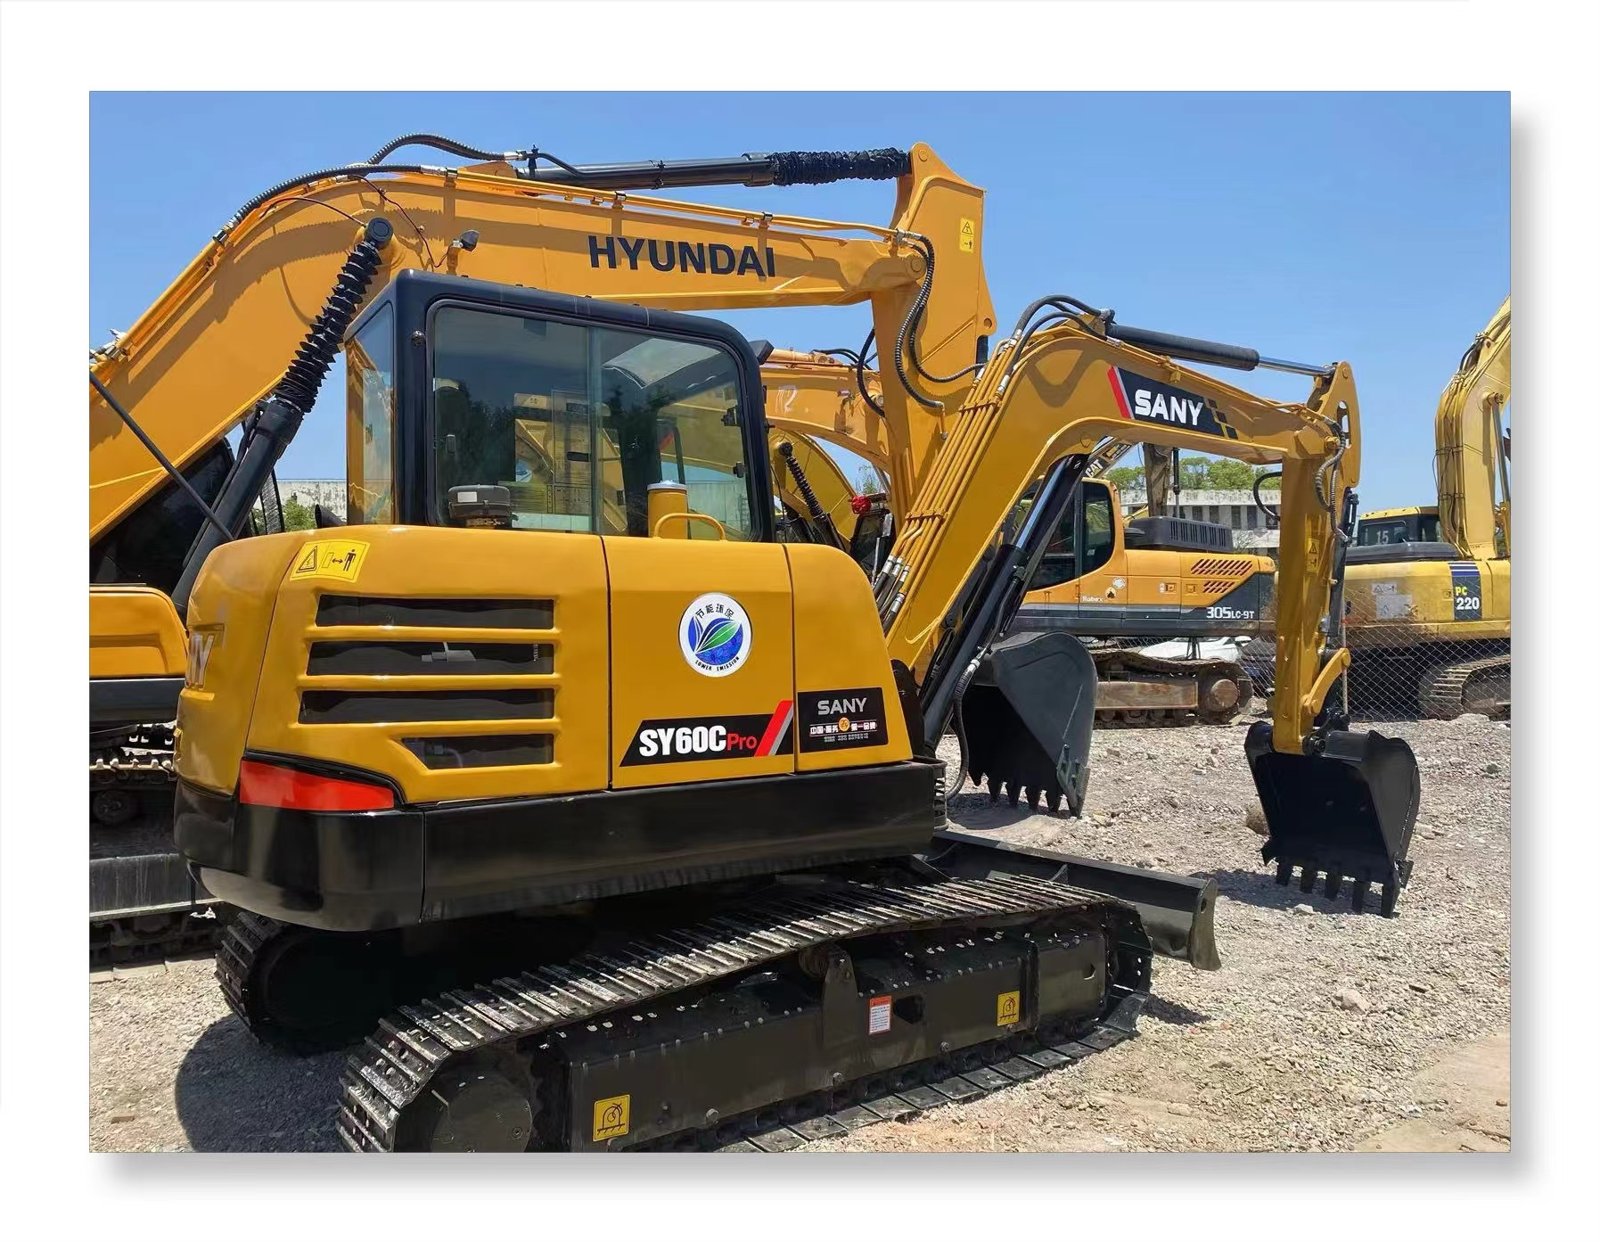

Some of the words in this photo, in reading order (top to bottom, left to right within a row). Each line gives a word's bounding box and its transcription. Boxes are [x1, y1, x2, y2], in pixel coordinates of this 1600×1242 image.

[588, 235, 776, 278] HYUNDAI
[1134, 389, 1204, 426] SANY
[1085, 459, 1104, 478] CAT
[1455, 586, 1468, 596] PC
[1206, 606, 1255, 619] 305LC-9T
[1456, 597, 1480, 610] 220
[817, 697, 867, 716] SANY
